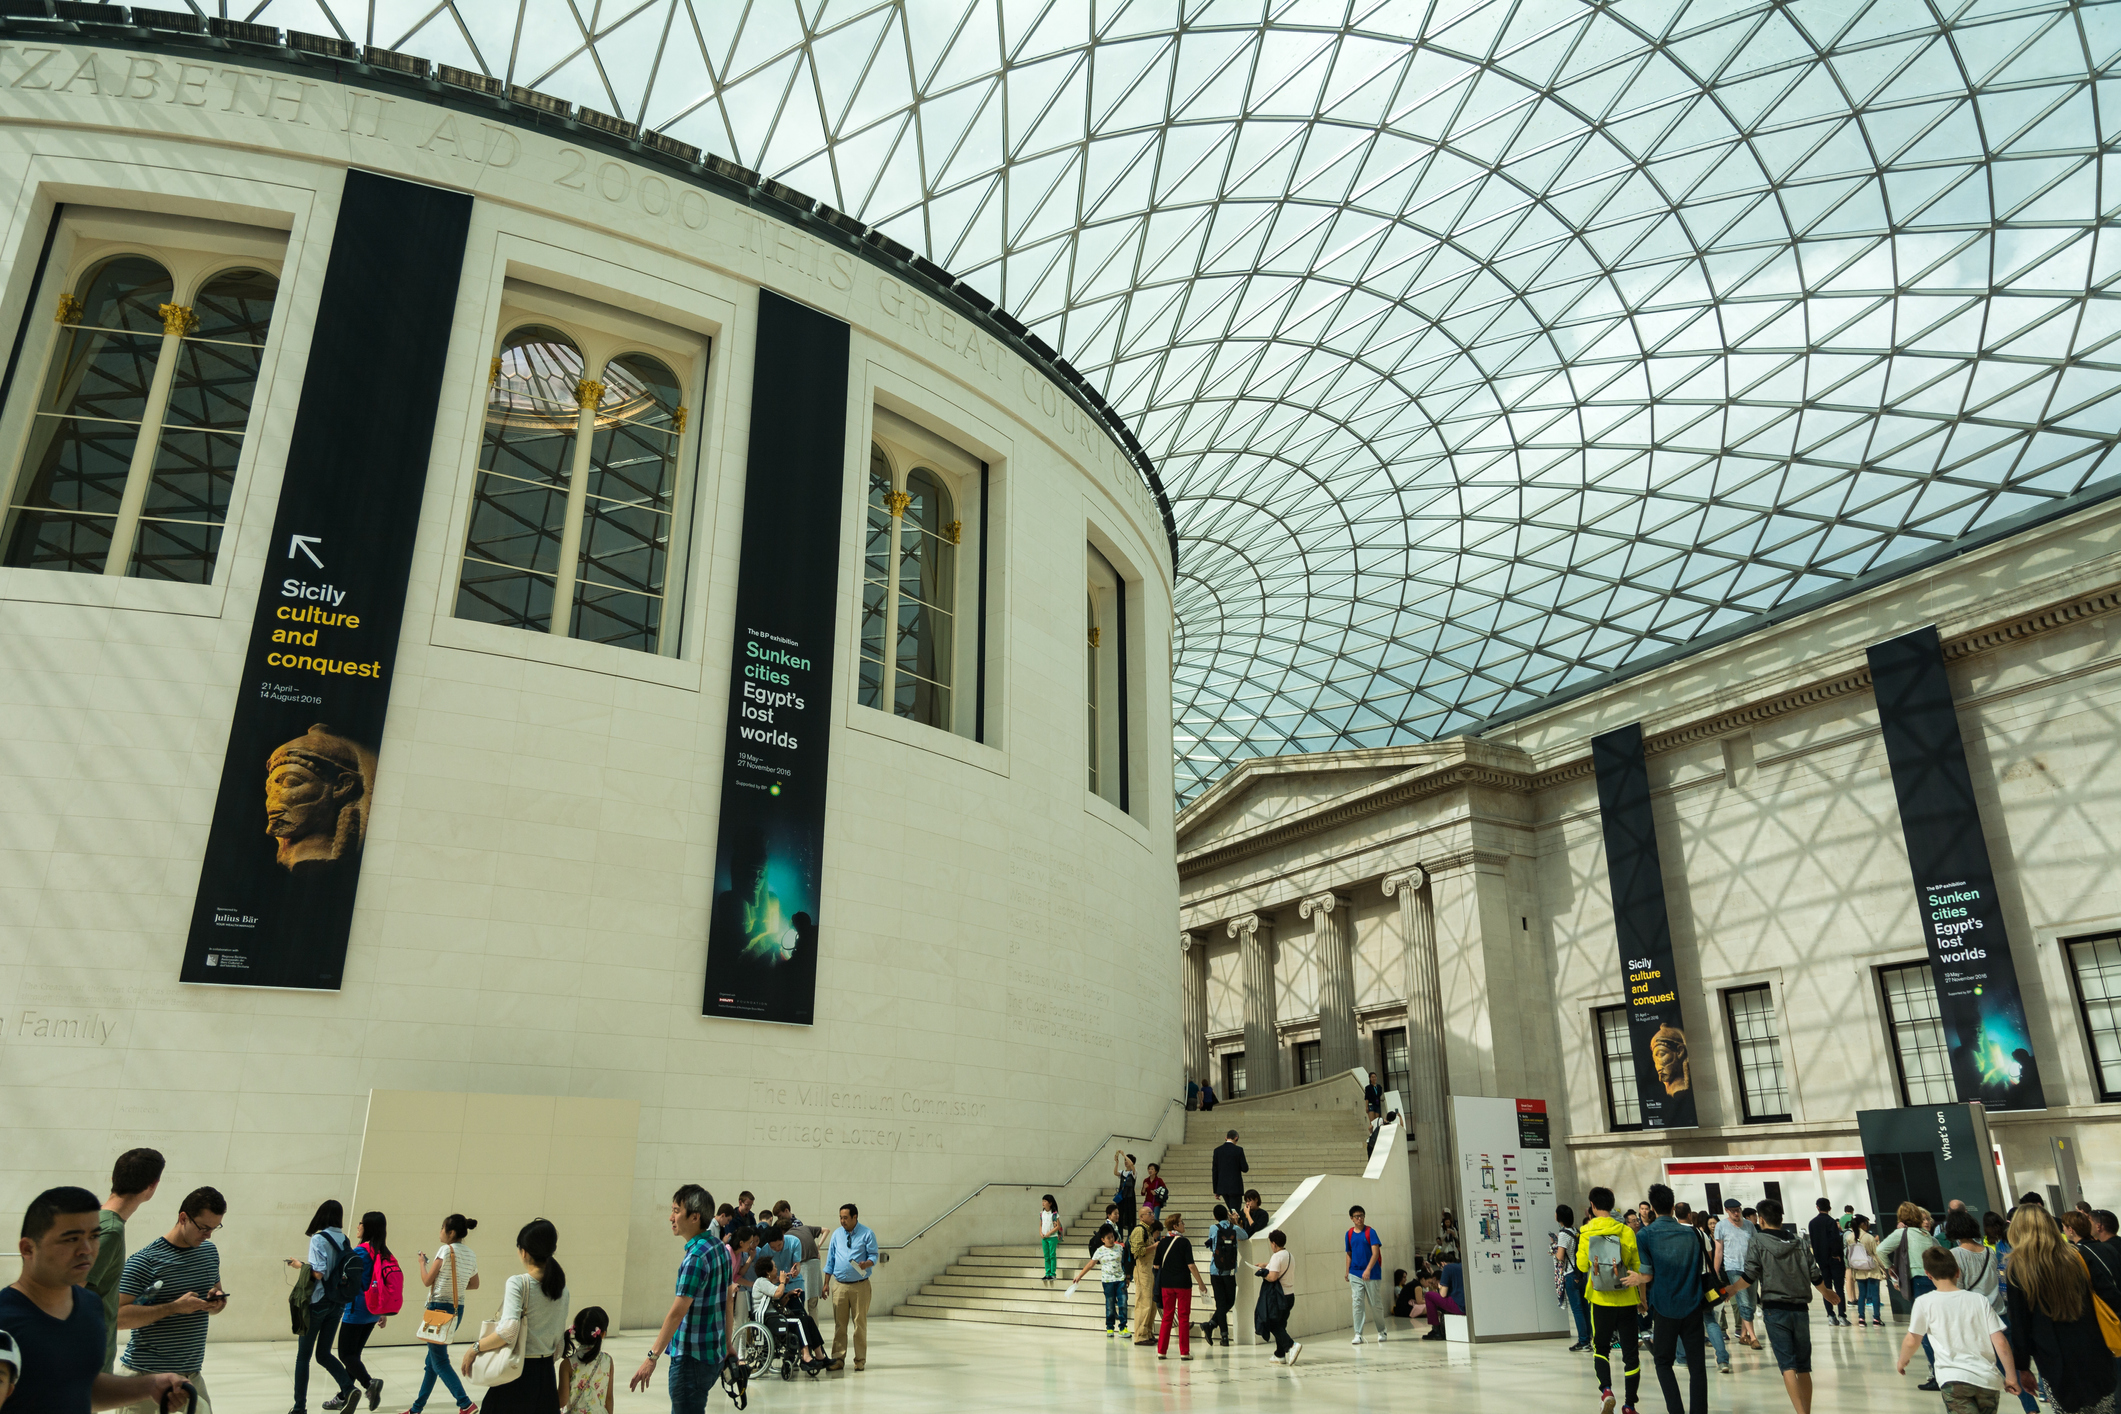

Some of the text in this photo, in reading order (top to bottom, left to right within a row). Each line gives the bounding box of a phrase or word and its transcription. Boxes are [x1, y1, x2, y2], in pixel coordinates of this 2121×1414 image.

[341, 91, 397, 142] II
[416, 113, 522, 169] AD
[554, 148, 710, 231] 2000
[734, 207, 854, 292] THIS
[877, 275, 1008, 382] GREAT
[1022, 365, 1106, 464] COURT
[281, 578, 347, 607] Sicily
[276, 605, 360, 629] culture
[271, 629, 319, 647] and
[747, 627, 799, 647] The BP exhibition
[746, 641, 811, 671] Sunken
[267, 652, 381, 679] conquest
[744, 663, 790, 686] cities
[261, 682, 272, 690] 21
[274, 683, 293, 693] April
[743, 680, 805, 710] Egypt's
[270, 692, 300, 703] August
[301, 695, 322, 705] 2016
[741, 701, 774, 724] lost
[740, 726, 798, 750] worlds
[747, 753, 759, 763] May
[737, 759, 792, 777] 27 November 2016
[1942, 880, 1967, 889] exhibition
[1928, 890, 1980, 907] Sunken
[214, 913, 259, 924] Julius Bär
[1931, 907, 1968, 920] cities
[1934, 918, 1984, 935] Egypt's
[1008, 941, 1020, 955] BP
[1936, 935, 1963, 949] lost
[1939, 947, 1987, 963] worlds
[1628, 957, 1653, 971] Sicily
[1629, 969, 1661, 982] culture
[1974, 972, 1988, 980] 2016
[1631, 982, 1649, 994] and
[1633, 990, 1675, 1006] conquest
[18, 1010, 118, 1046] Family
[753, 1080, 987, 1118] The Millennium Commission
[752, 1117, 944, 1152] Heritage Lottery Fund
[1936, 1111, 1953, 1161] What's on
[1723, 1163, 1755, 1172] Membership
